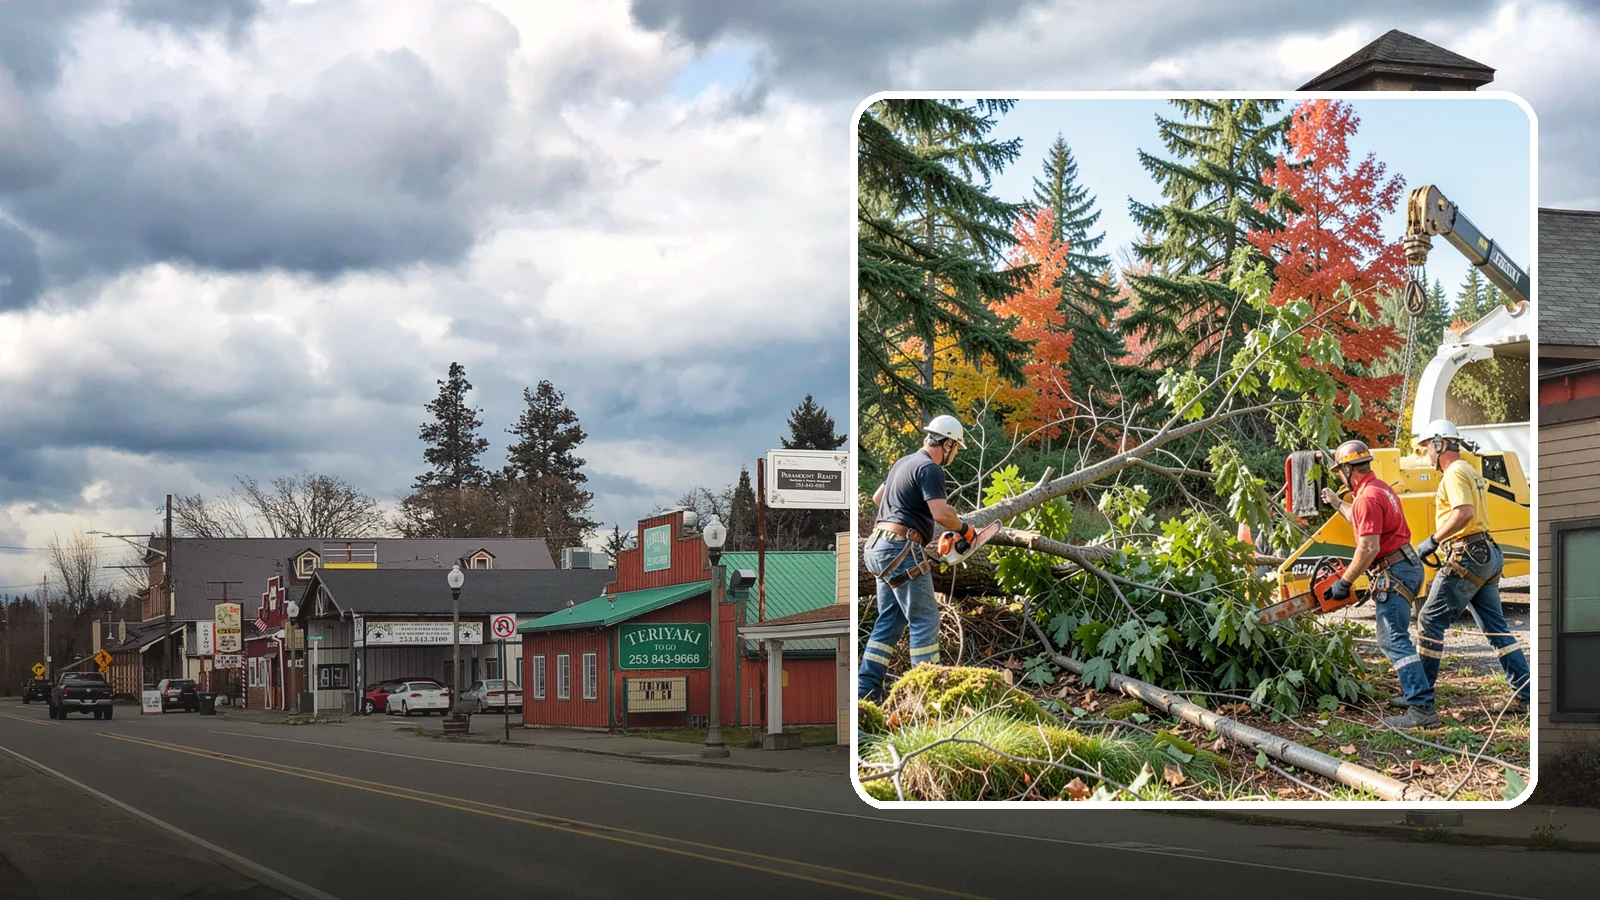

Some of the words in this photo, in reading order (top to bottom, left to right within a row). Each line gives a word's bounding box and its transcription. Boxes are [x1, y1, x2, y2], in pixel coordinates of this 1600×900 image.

[781, 471, 814, 479] PARAMOUNT
[625, 628, 702, 646] TERIYAKI
[629, 655, 648, 664] 253
[652, 654, 700, 664] 843-9668
[639, 681, 672, 690] TERIYAKI
